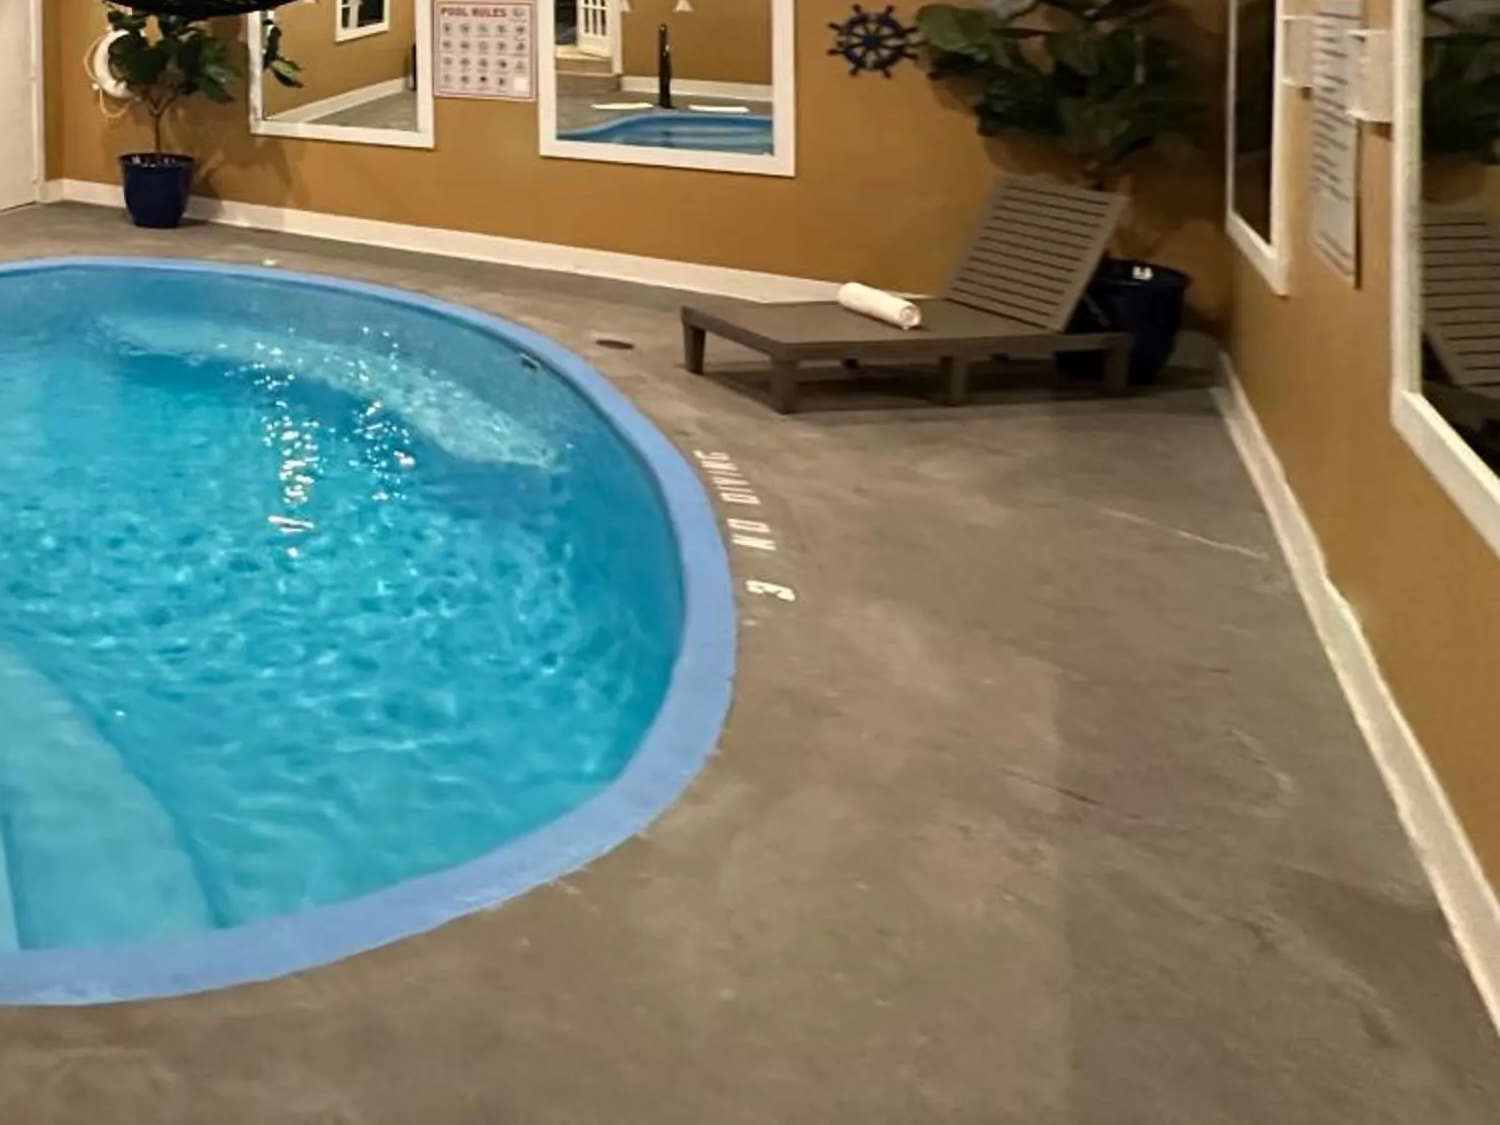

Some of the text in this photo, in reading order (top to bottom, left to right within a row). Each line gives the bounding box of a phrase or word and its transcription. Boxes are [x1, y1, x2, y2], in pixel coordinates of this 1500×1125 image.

[441, 7, 507, 18] POOL RULES
[692, 449, 777, 551] NO DIVING
